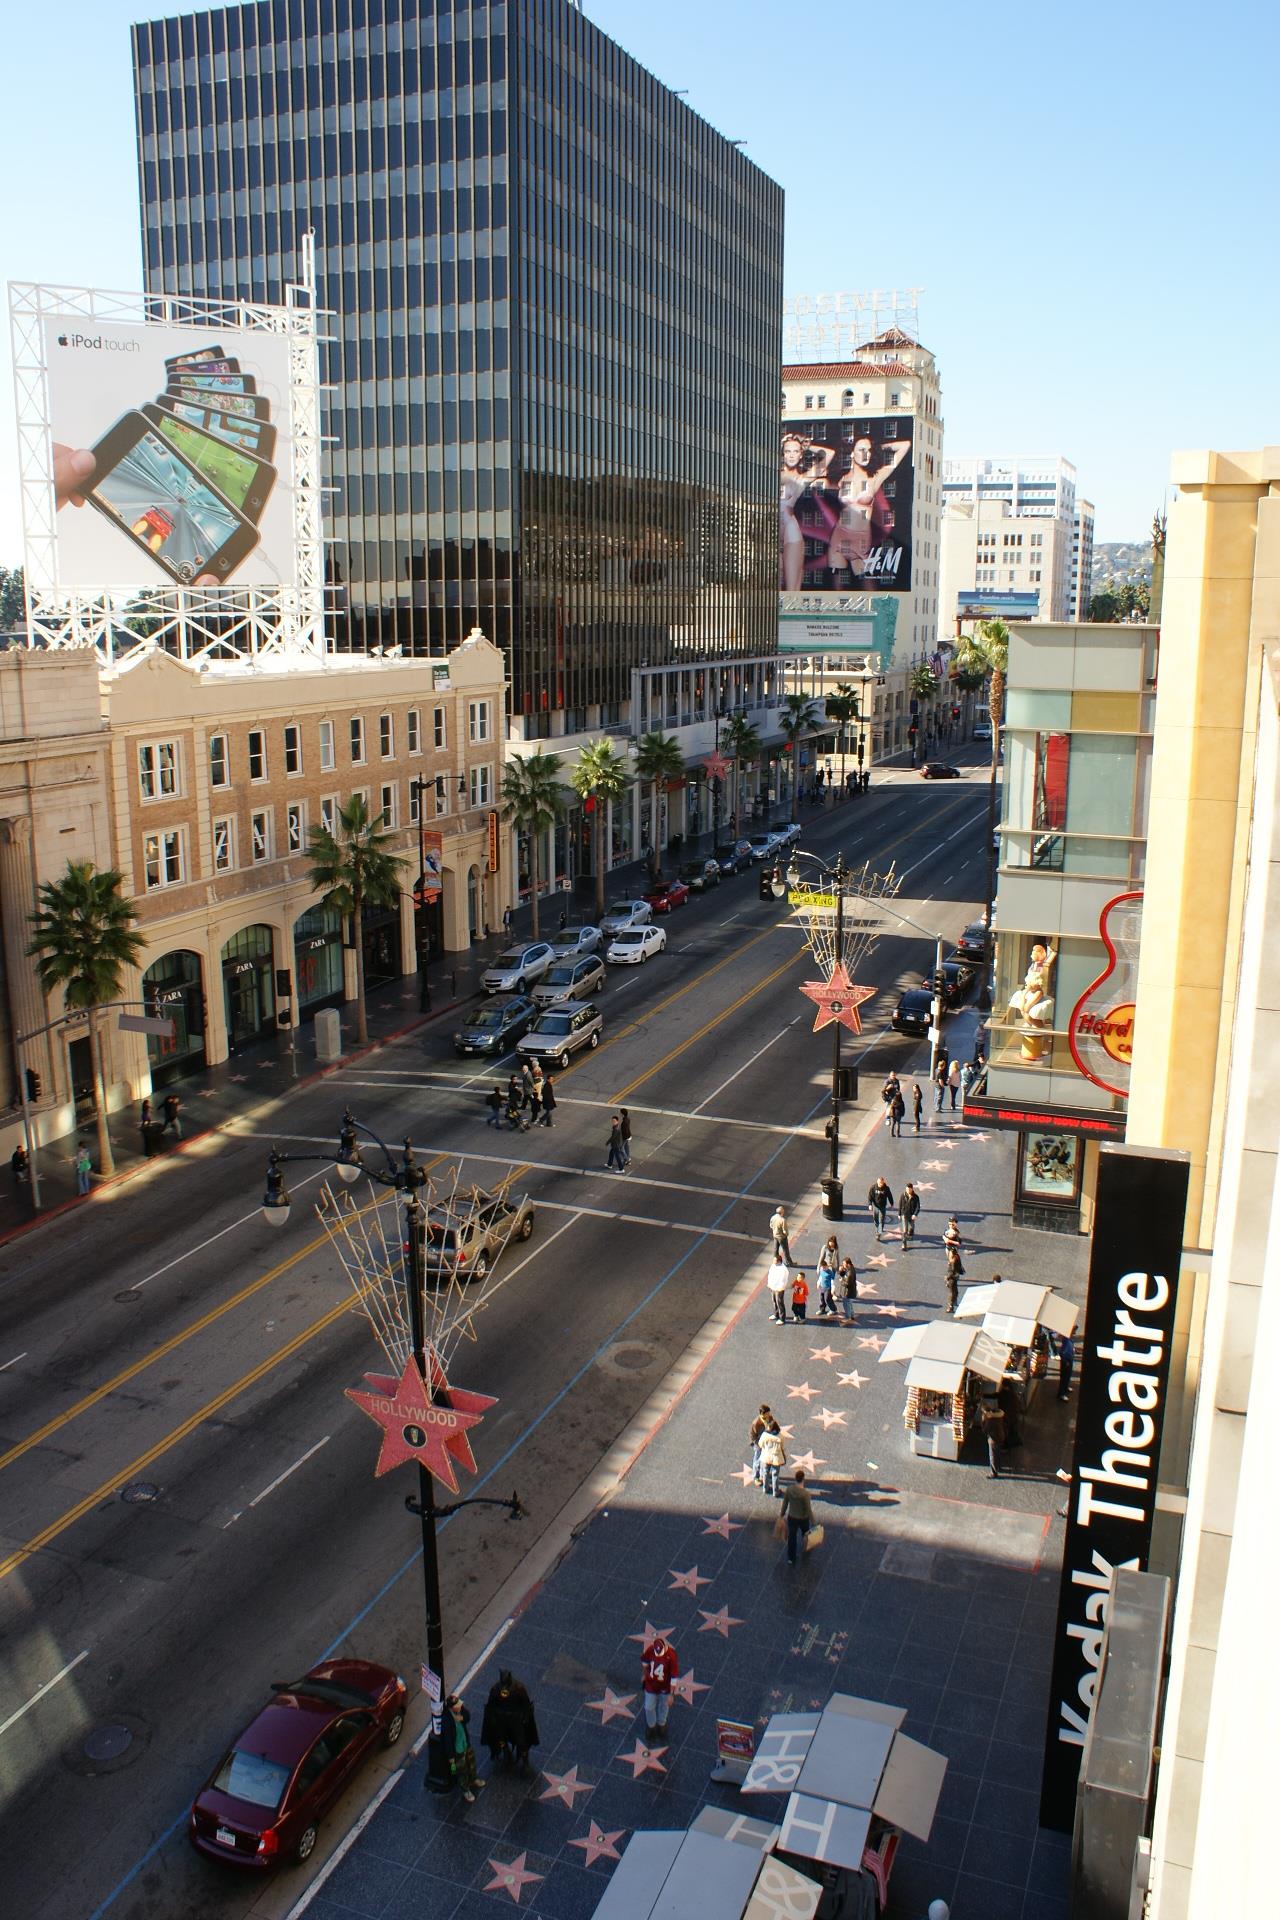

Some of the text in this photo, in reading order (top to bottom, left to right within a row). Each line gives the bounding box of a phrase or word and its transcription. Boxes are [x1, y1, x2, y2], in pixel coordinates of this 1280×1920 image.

[782, 287, 925, 315] OSEVELT
[71, 333, 141, 353] iPod touch
[863, 546, 903, 576] H&M
[812, 895, 834, 906] XING
[310, 938, 326, 949] ZARA
[235, 962, 253, 974] ZARA
[162, 990, 182, 1003] ZARA
[814, 989, 861, 1000] HOLLYWOOD
[1078, 1013, 1135, 1038] Hard
[998, 1110, 1025, 1122] ROCK
[1026, 1113, 1053, 1125] SHOP
[1053, 1116, 1080, 1129] NOW
[1076, 1272, 1169, 1527] Theatre
[370, 1399, 458, 1428] HOLLYWOOD
[649, 1660, 665, 1681] 14
